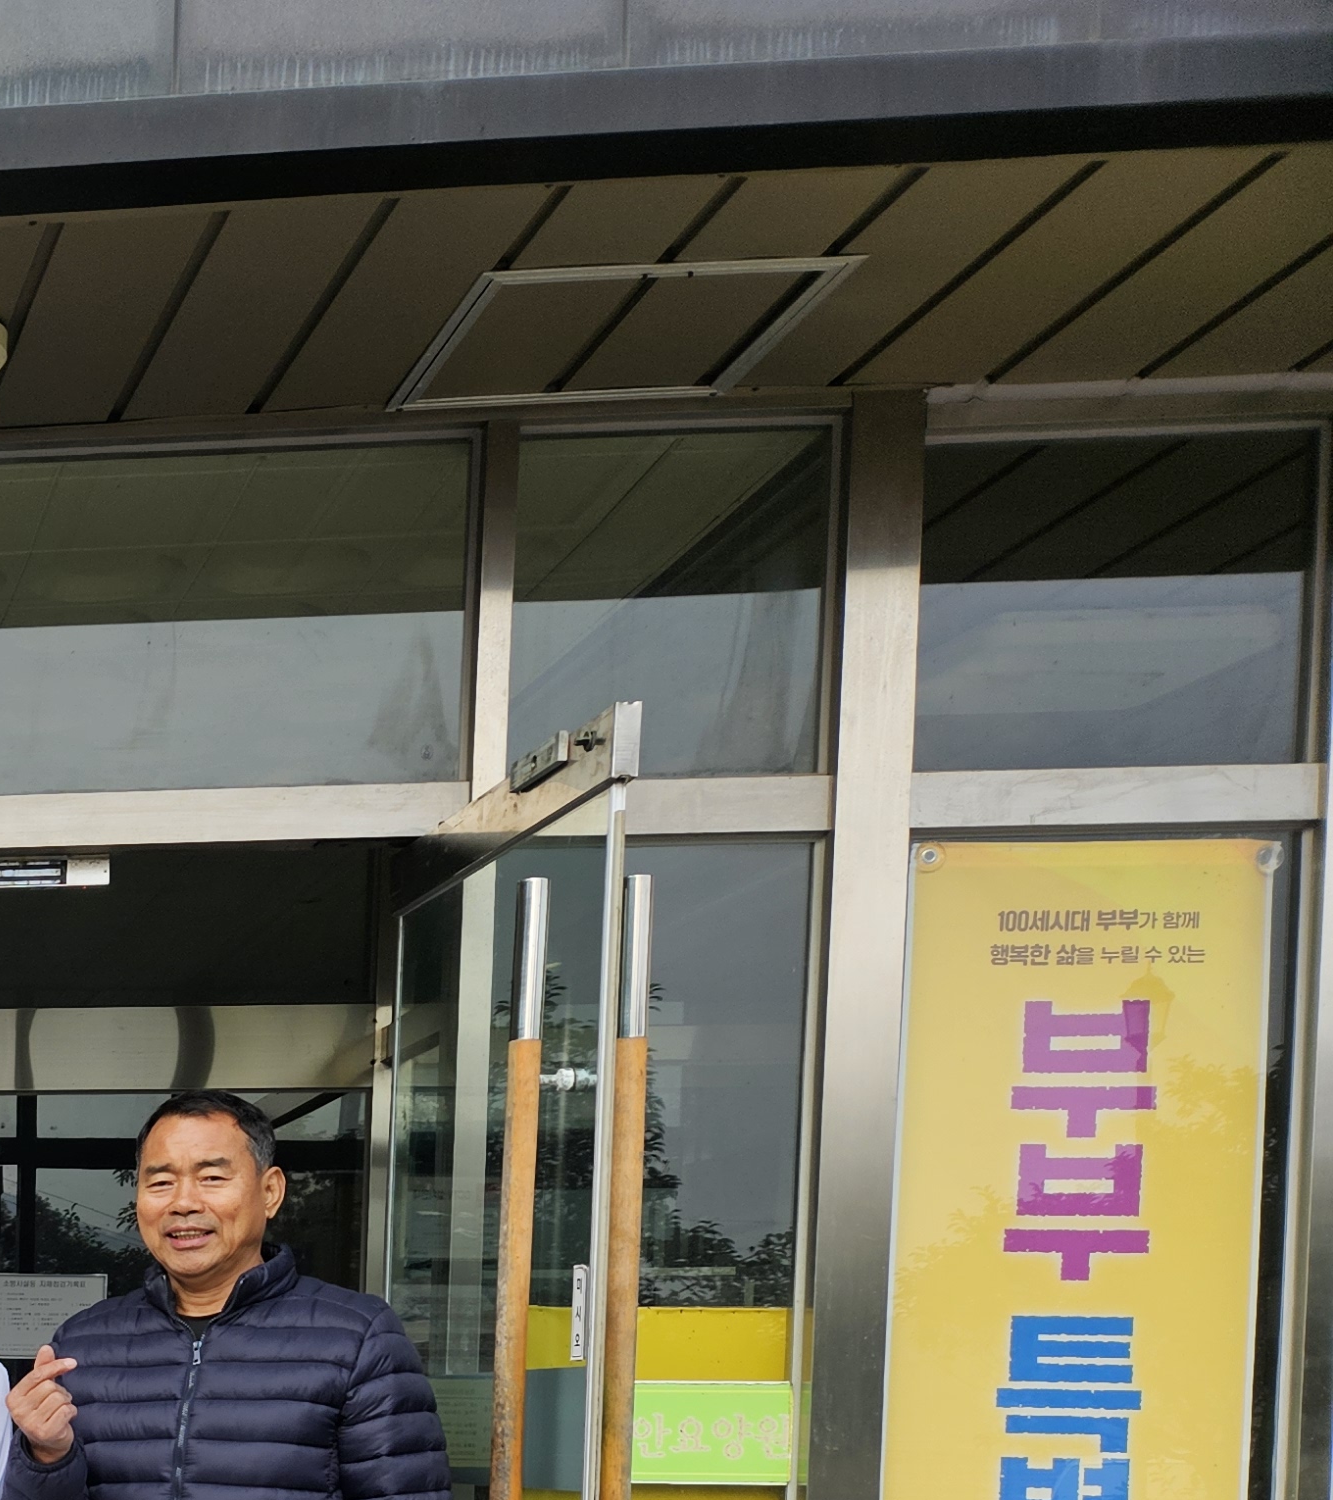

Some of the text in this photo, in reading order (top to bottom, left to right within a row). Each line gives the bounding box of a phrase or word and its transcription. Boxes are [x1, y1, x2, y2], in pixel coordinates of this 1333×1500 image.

[997, 908, 1200, 933] 100세시대 부부가 함께
[989, 942, 1205, 967] 행복한 삶을 누릴 수 있는
[1003, 1000, 1157, 1281] 부부
[573, 1277, 583, 1347] 미시오
